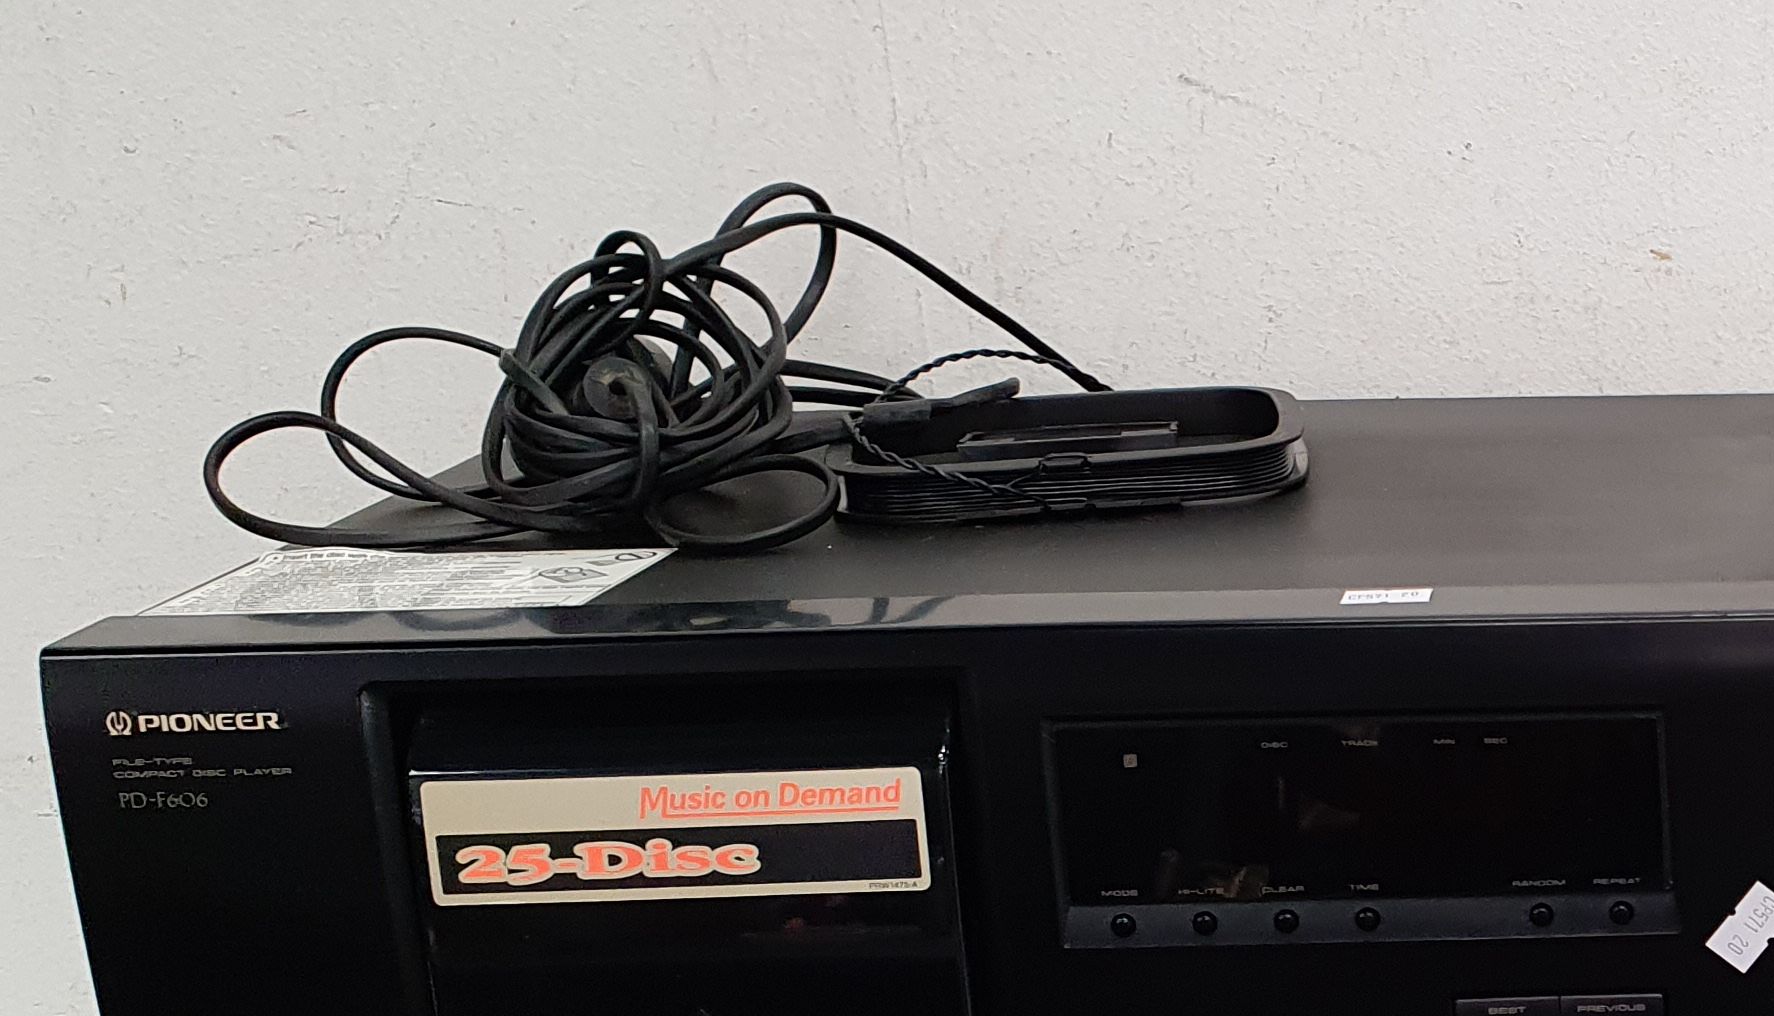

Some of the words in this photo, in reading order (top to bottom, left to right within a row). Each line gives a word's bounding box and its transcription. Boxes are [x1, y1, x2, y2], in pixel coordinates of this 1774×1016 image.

[137, 711, 283, 733] PIONEER
[113, 769, 185, 779] COMPACT
[192, 768, 227, 778] DISC
[233, 767, 293, 777] PLAYER
[117, 791, 209, 809] PD-F606
[639, 783, 724, 819] Music
[734, 786, 771, 808] on
[778, 778, 901, 807] Demand
[454, 837, 763, 887] 25-Disc
[1487, 1005, 1528, 1016] BEST
[1576, 1003, 1647, 1013] PREVIOUS
